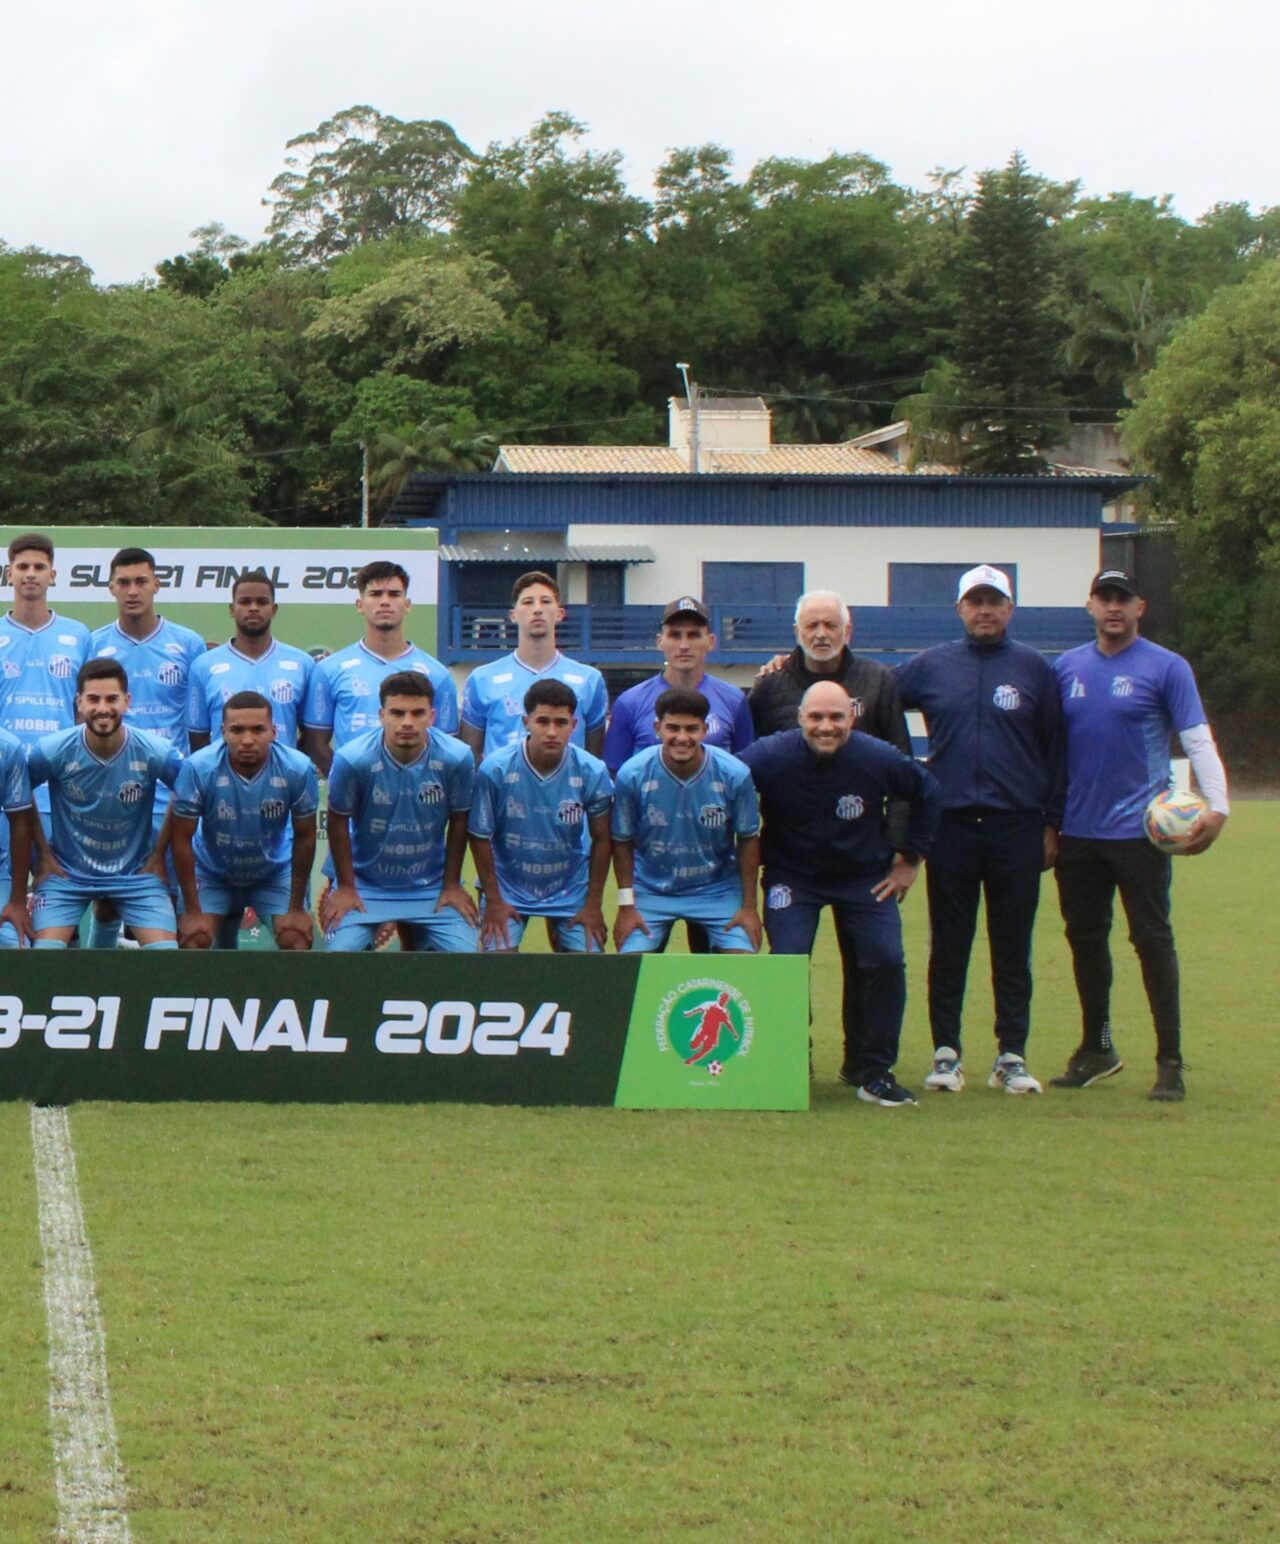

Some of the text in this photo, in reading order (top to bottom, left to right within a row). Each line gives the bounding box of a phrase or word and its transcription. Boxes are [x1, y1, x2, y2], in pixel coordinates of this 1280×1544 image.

[302, 567, 364, 589] 202
[143, 997, 348, 1054] FINAL
[373, 999, 572, 1056] 2024
